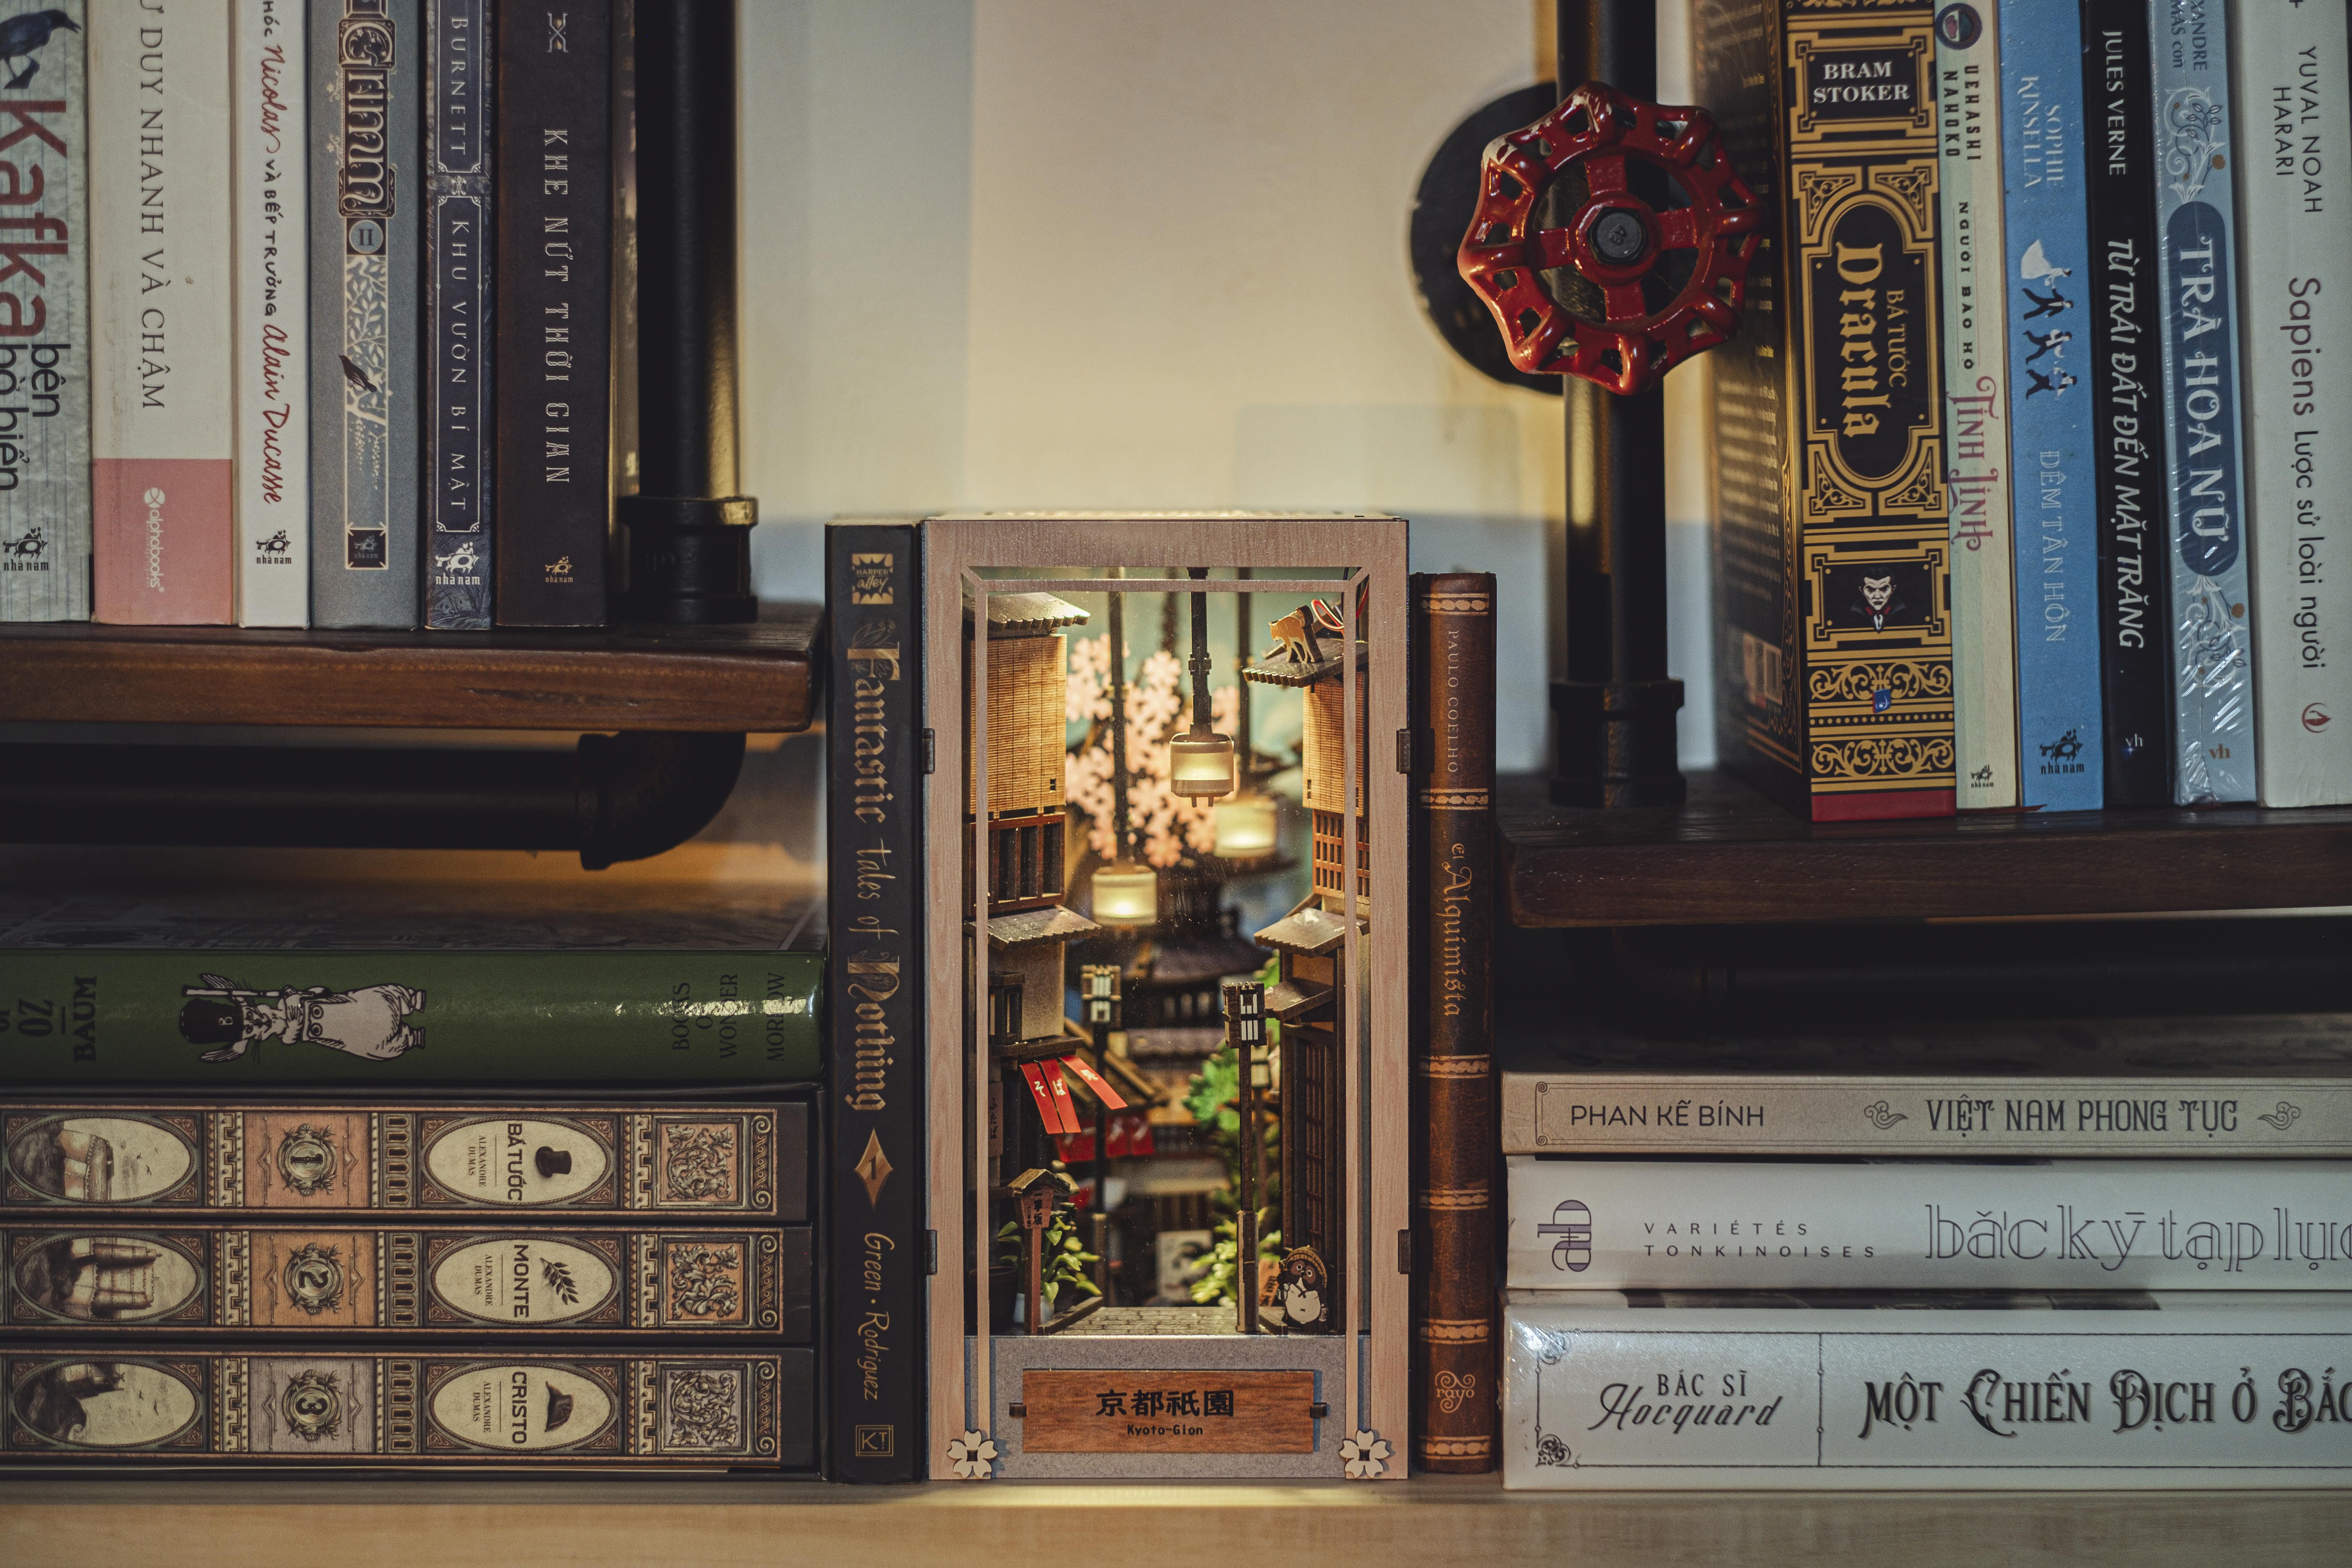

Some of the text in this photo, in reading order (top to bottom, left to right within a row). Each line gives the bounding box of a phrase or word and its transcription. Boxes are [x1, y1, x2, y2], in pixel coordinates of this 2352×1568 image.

[141, 26, 163, 95] DUY
[451, 17, 469, 156] BURNETT
[1813, 84, 1910, 104] STOKER
[1823, 61, 1893, 80] BRAM
[2171, 41, 2184, 69] con
[260, 44, 288, 154] Nicolas
[341, 21, 394, 209] Grimm
[1943, 70, 1960, 157] NAHOKO
[1964, 64, 1982, 161] UEHASHI
[2017, 75, 2042, 188] KINSELLA
[2102, 30, 2126, 176] JULES VERNE
[2273, 87, 2294, 176] HARARI
[2298, 46, 2323, 213] YUVAL NOAH
[141, 108, 164, 234] NHANH
[264, 160, 275, 183] VÀ
[2046, 104, 2064, 188] SOPHIE
[0, 100, 68, 337] Kafka
[265, 190, 284, 225] BẾP
[142, 248, 171, 296] VÀ
[265, 230, 282, 317] TRƯỞNG
[544, 129, 574, 483] KHE NỨT THỜI GIAN
[137, 309, 170, 408] CHẬM
[448, 221, 471, 510] KHU VƯỜN BÍ MẬT
[1835, 241, 1893, 438] Dracula
[1886, 289, 1912, 389] BÁ TƯỚC
[31, 344, 71, 417] bên
[262, 322, 290, 504] Alain Ducasse
[2179, 234, 2231, 542] TRÀ HOA NỮ
[2108, 239, 2149, 649] TỪ TRÁI ĐẤT ĐẾN MẶT TRĂNG
[2280, 277, 2326, 668] Sapiens Lược sử loài người
[26, 562, 49, 571] nam
[458, 574, 481, 585] nam
[856, 575, 889, 593] alley
[2040, 450, 2070, 643] ĐÊM TÂN HÔN
[1447, 630, 1459, 773] PAULO COELHO
[2063, 762, 2084, 773] nam
[2208, 744, 2231, 760] vh
[845, 642, 901, 1110] Fantastic tales of Nothing
[1435, 861, 1472, 1016] Alquimista
[17, 998, 54, 1037] OZ
[74, 975, 98, 1063] BAUM
[720, 973, 738, 1059] WONER
[1571, 1099, 1764, 1127] PHAN KẾ BÍNH
[1926, 1093, 2239, 1139] VIỆT NAM PHONG TỤC
[478, 1135, 487, 1187] ALEXANDRE
[507, 1122, 526, 1202] BÁ TƯỚC
[1644, 1220, 1808, 1236] VARIÉTÉS
[1644, 1245, 1875, 1258] TONKINOISES
[484, 1254, 493, 1306] ALEXANDRE
[514, 1244, 530, 1318] MONTE
[857, 1231, 895, 1401] Green Rodriguez
[472, 1392, 481, 1422] DUMAS
[482, 1381, 492, 1433] ALEXANDRE
[511, 1371, 527, 1444] CRISTO
[1435, 1386, 1475, 1405] rayo
[1588, 1381, 1784, 1434] Hocquard
[1657, 1369, 1749, 1397] BÁC SĨ
[1858, 1372, 1943, 1439] MỘT
[1960, 1368, 2092, 1438] CHIẾN
[2110, 1369, 2216, 1434] DỊCH
[2232, 1366, 2259, 1424] Ở
[1127, 1424, 1204, 1436] Kyoto-Gion
